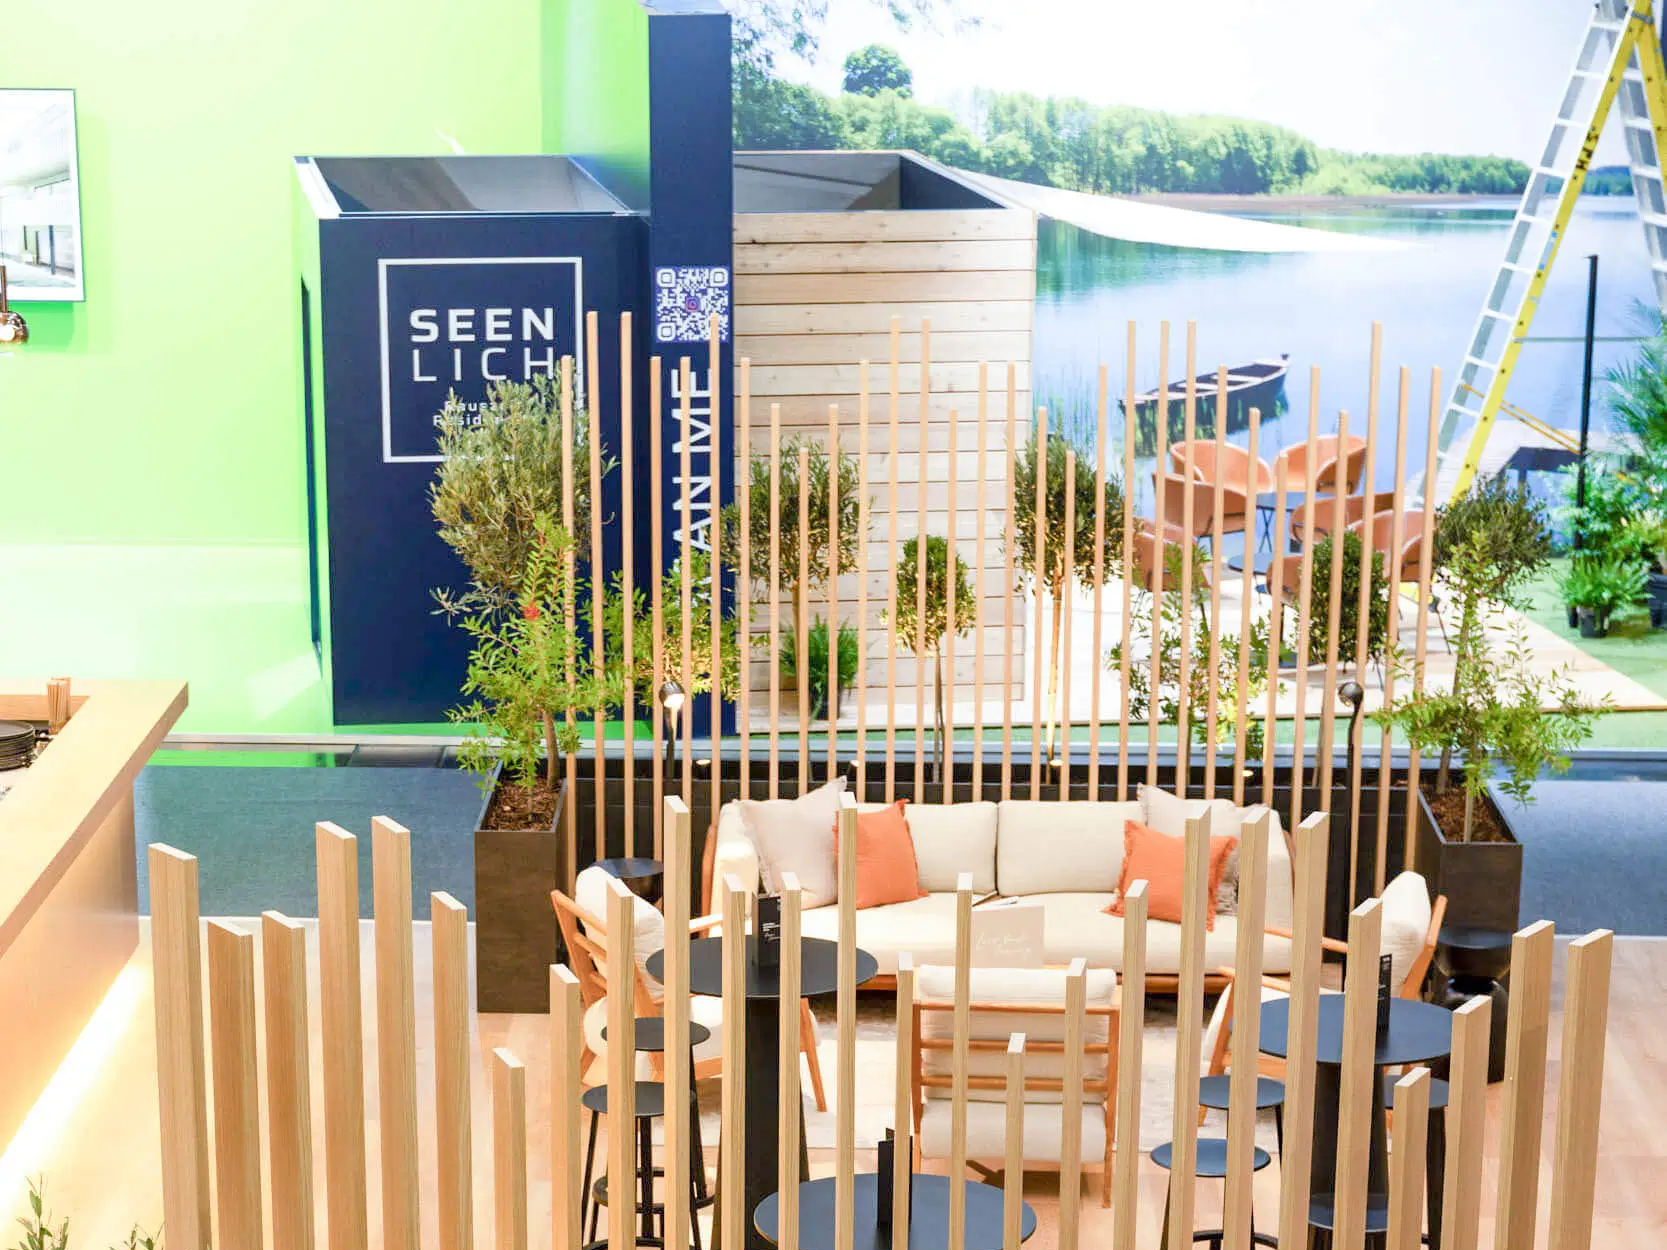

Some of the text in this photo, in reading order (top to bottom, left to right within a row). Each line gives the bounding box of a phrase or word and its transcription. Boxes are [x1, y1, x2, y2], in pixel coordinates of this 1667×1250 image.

[410, 307, 554, 343] SEEN
[412, 347, 555, 382] LICH
[671, 368, 714, 454] ME
